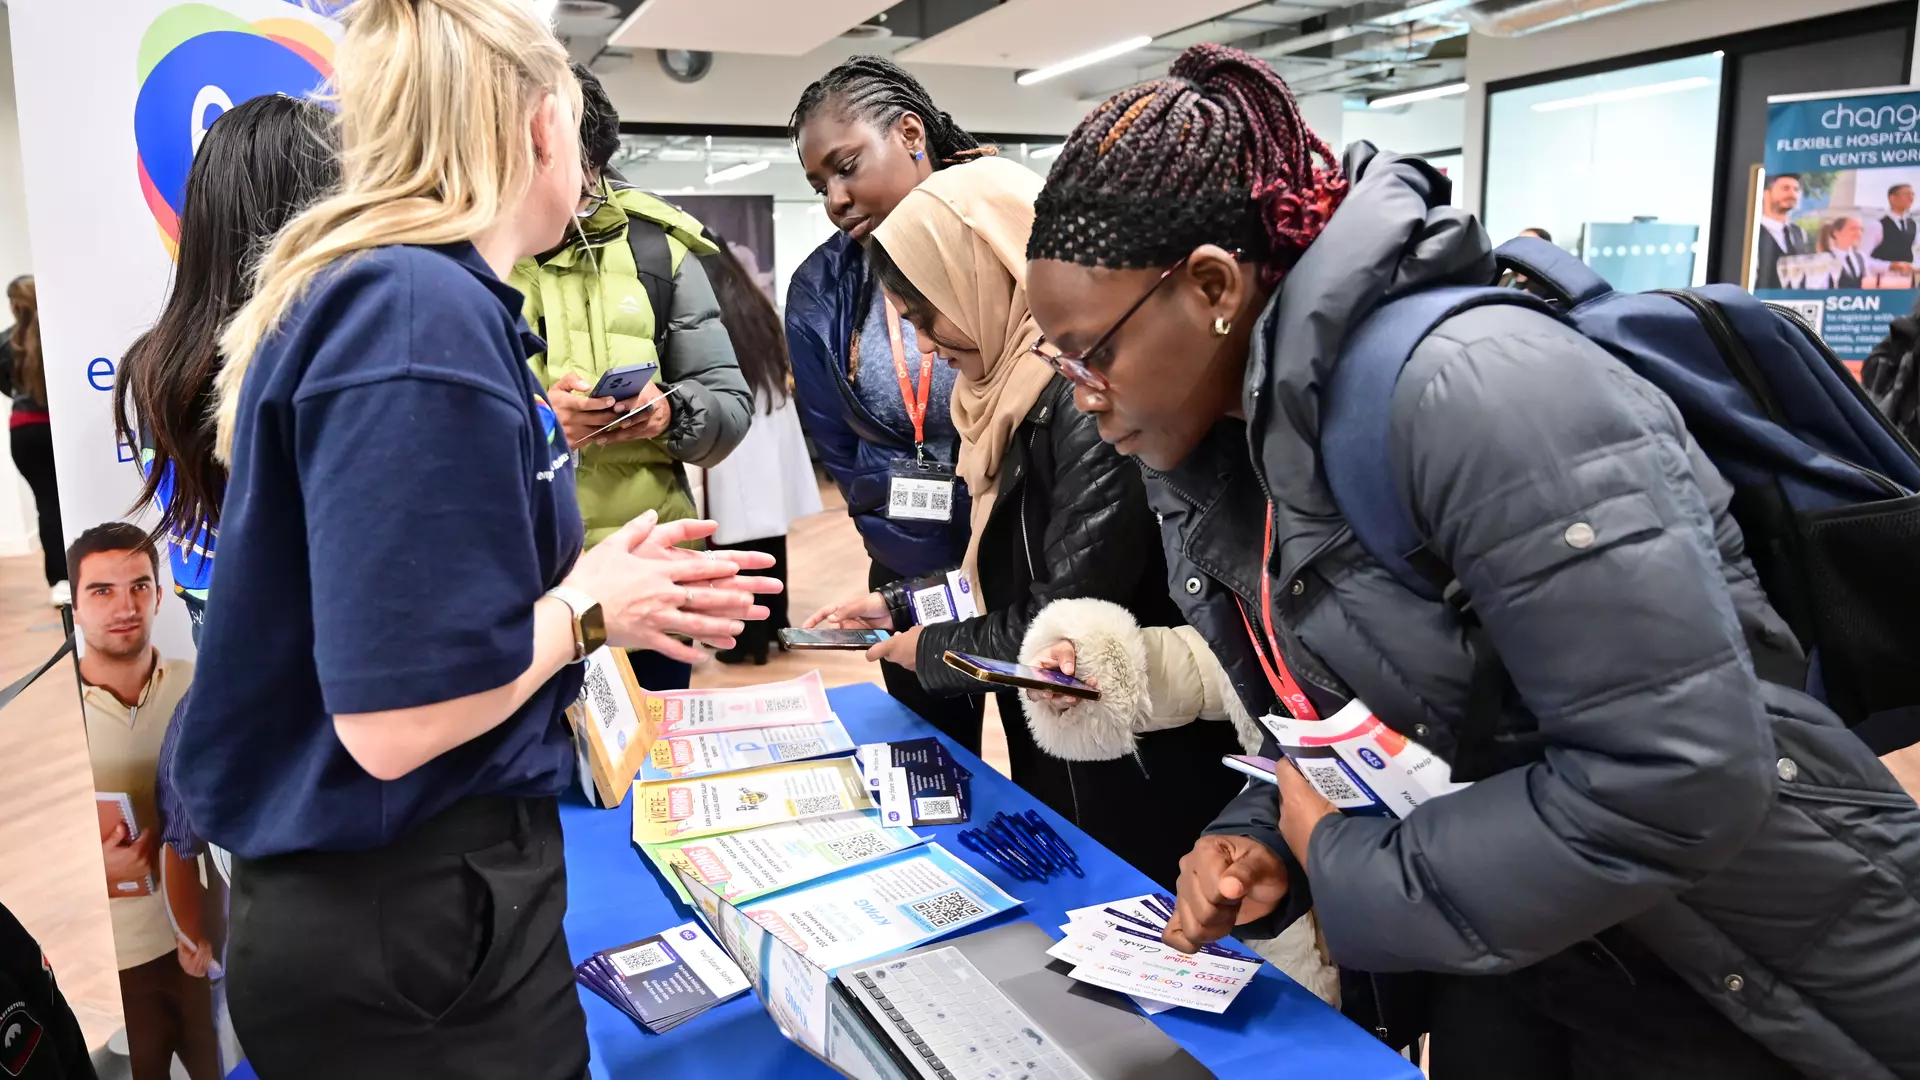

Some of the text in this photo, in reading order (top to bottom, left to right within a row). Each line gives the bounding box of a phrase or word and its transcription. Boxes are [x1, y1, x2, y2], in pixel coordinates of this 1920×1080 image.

[1821, 103, 1920, 131] chang
[1777, 135, 1843, 152] FLEXIBLE
[1820, 149, 1920, 167] EVENTS WOR
[1825, 295, 1880, 311] SCAN
[1838, 313, 1872, 323] register
[1825, 324, 1860, 333] working
[1361, 749, 1382, 768] e4s
[1413, 758, 1431, 772] Help
[670, 788, 690, 818] HIRING
[688, 847, 729, 881] HIRING
[854, 899, 891, 926] KPMG
[789, 912, 816, 937] VACATION
[803, 910, 839, 942] PROGRAMMES
[683, 930, 695, 941] e4s
[813, 936, 828, 948] 2024
[1118, 938, 1162, 954] Clarks
[1140, 972, 1183, 989] Google
[1194, 973, 1238, 985] TESCO
[1192, 984, 1229, 995] KPMG
